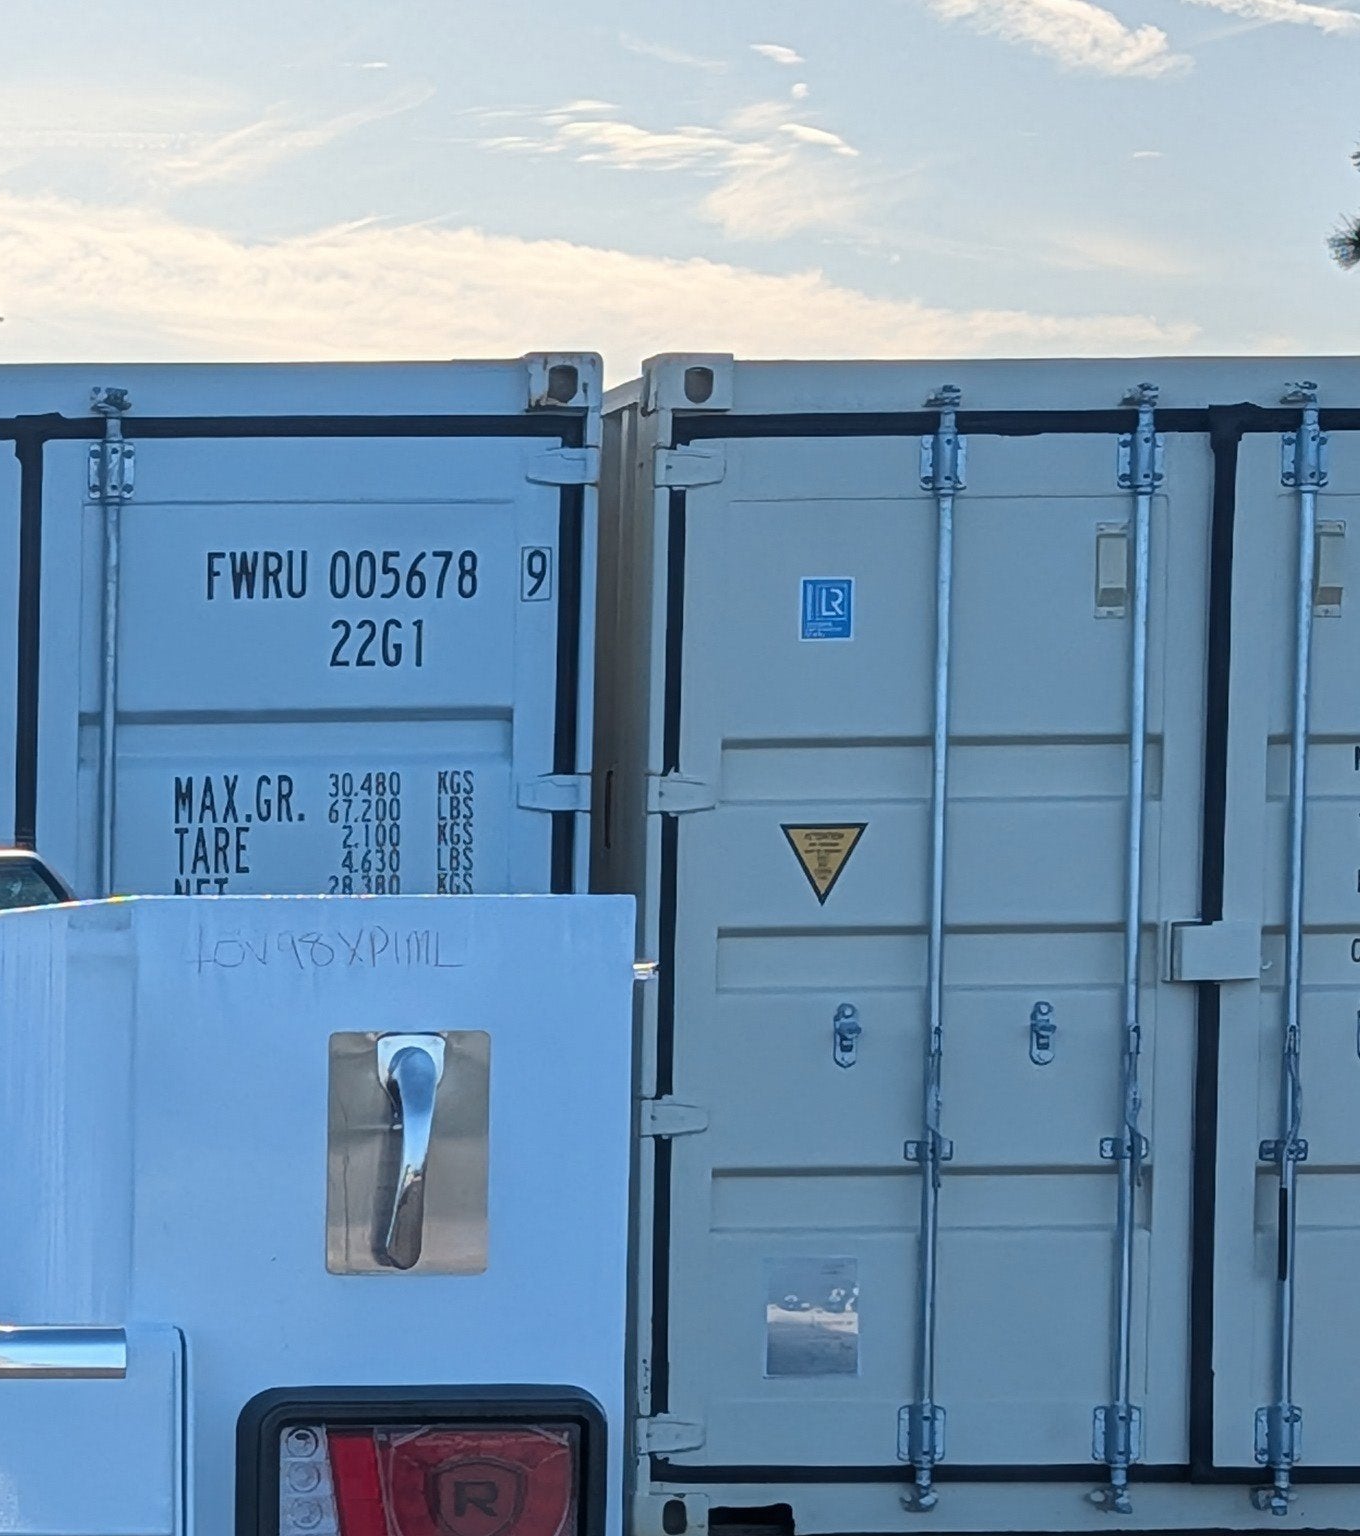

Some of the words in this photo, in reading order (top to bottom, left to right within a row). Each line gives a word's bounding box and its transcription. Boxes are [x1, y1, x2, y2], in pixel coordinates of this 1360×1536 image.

[206, 549, 308, 600] FWRU
[329, 549, 478, 599] 005678
[329, 618, 424, 668] 22G1
[328, 771, 401, 798] 30.480
[437, 770, 474, 796] KGS
[328, 797, 401, 824] 67.200
[437, 796, 474, 822] LBS
[174, 826, 250, 876] TARE
[341, 823, 401, 849] 2.100
[437, 822, 474, 847] KGS
[340, 848, 401, 874] 4.630
[437, 846, 474, 872] LBS
[328, 874, 401, 895] 28380
[436, 872, 474, 895] KGS
[453, 1480, 499, 1517] R
